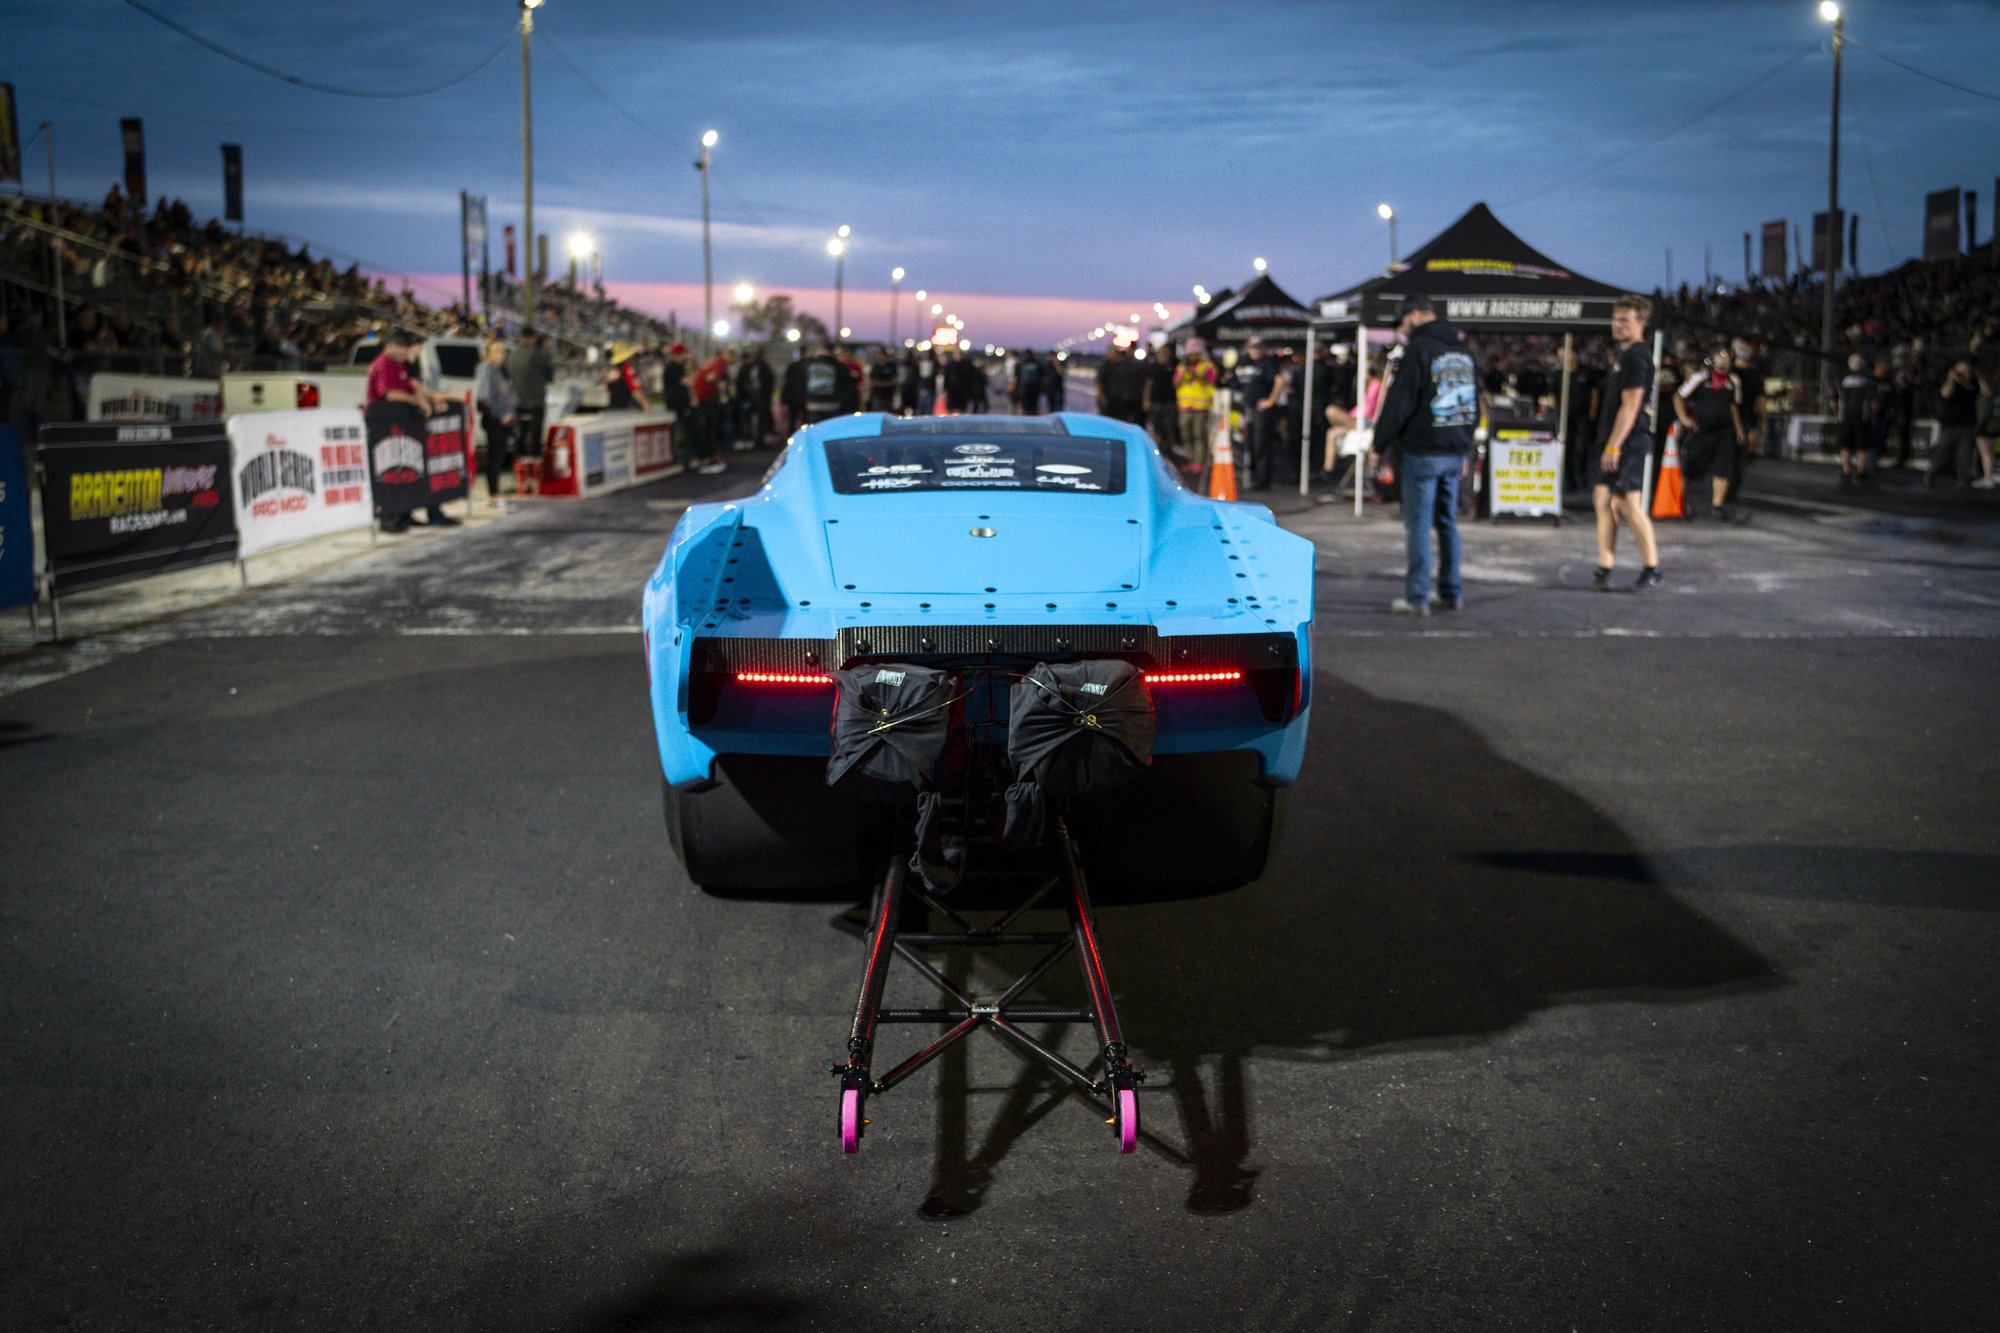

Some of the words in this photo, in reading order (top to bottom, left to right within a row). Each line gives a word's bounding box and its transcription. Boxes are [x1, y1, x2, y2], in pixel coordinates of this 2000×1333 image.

[70, 467, 163, 521] BRADENTON
[240, 450, 277, 509] WORLD
[279, 449, 316, 495] SERIES
[251, 499, 279, 517] PRO
[280, 495, 309, 513] MOD
